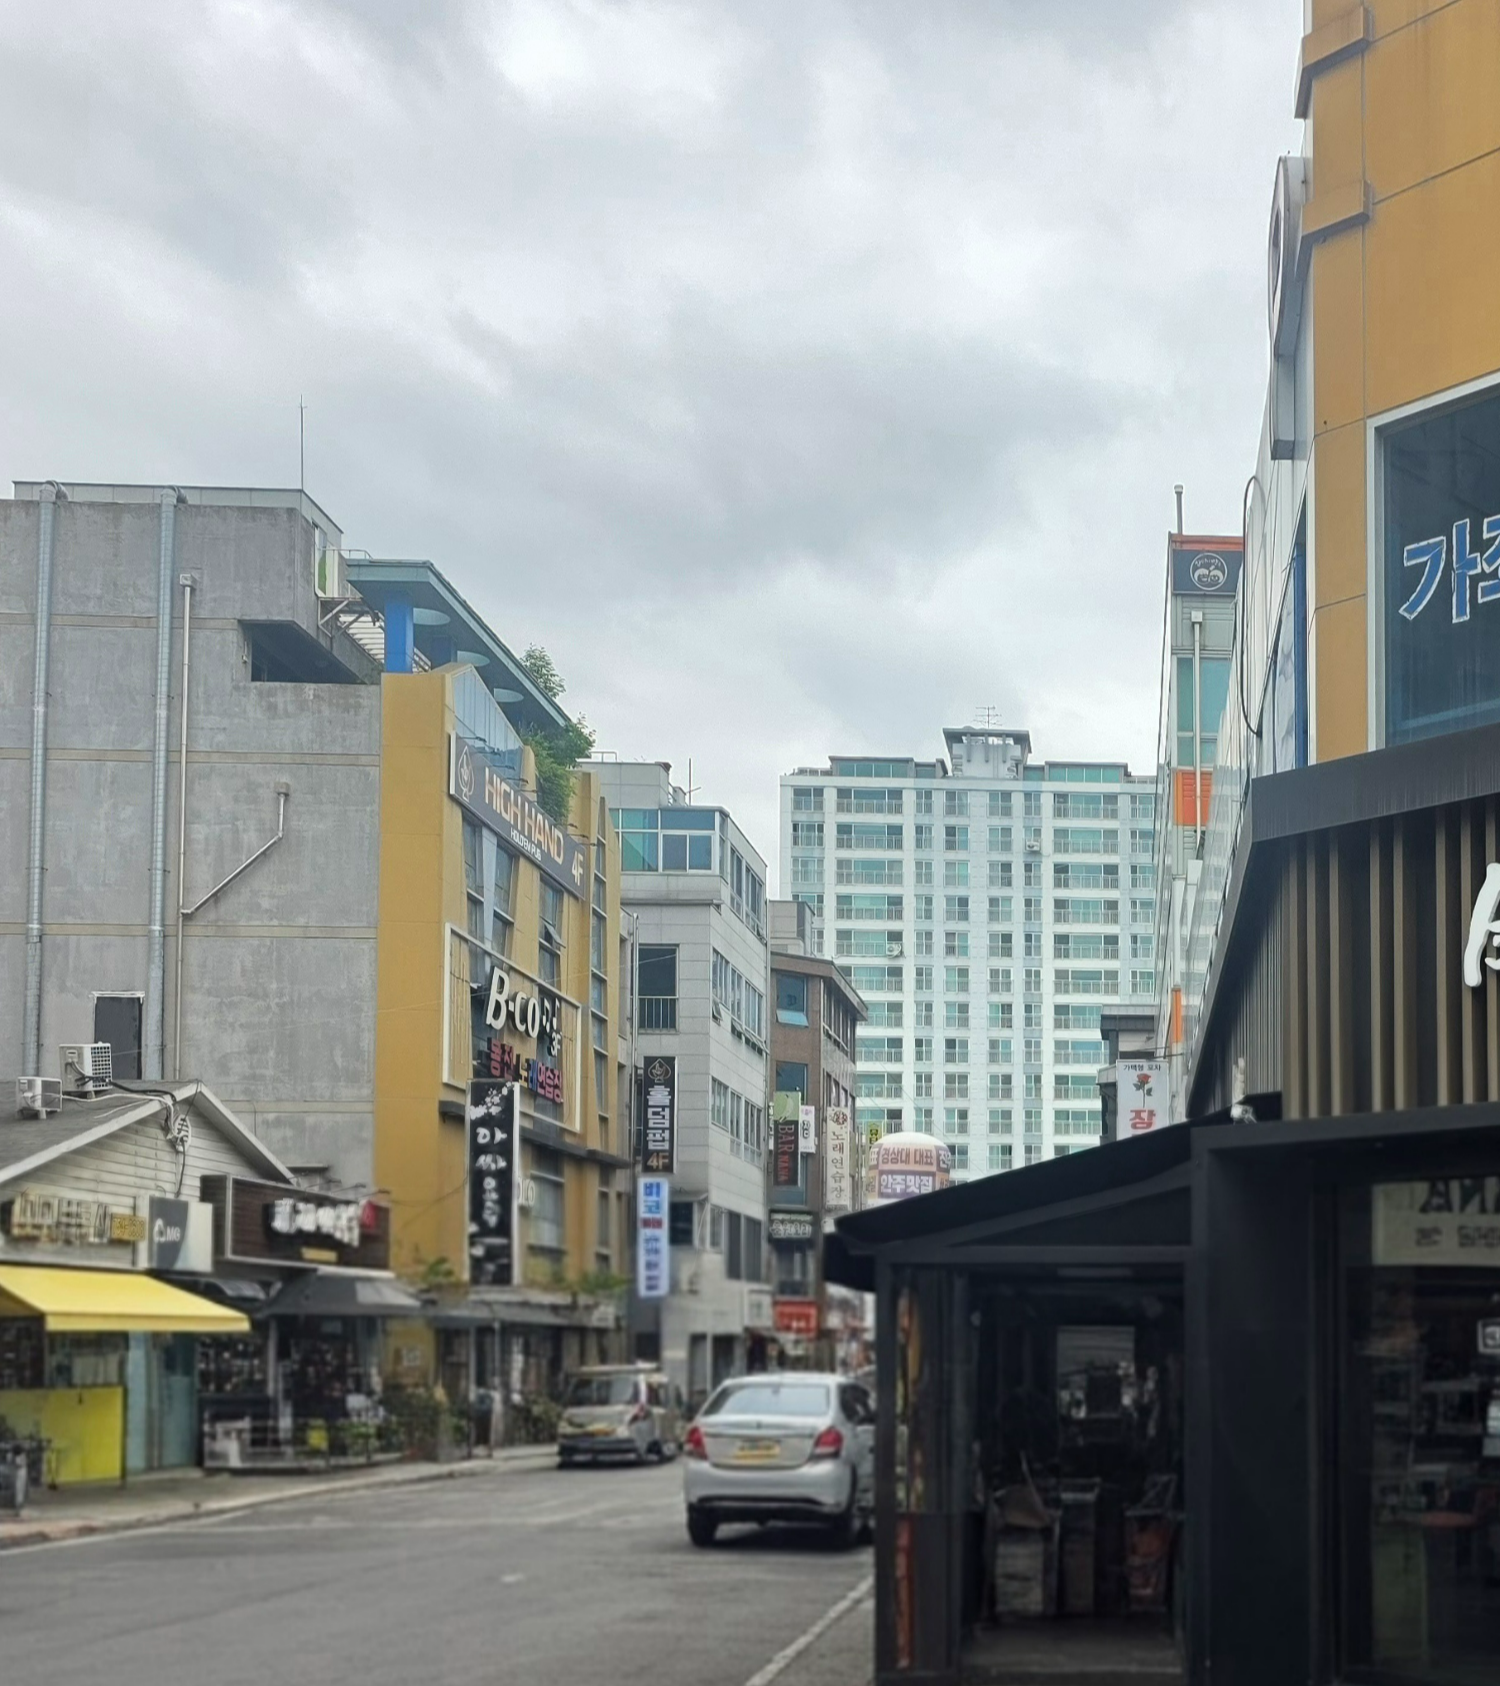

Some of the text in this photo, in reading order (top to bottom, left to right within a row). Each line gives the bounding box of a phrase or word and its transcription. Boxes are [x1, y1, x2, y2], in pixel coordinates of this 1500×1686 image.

[485, 766, 584, 887] HIGH HAND 4F
[647, 1085, 671, 1150] 홀덤펍
[1129, 1109, 1156, 1136] 장
[778, 1124, 795, 1153] BAR
[647, 1151, 669, 1170] 4F
[830, 1131, 846, 1199] 노래연습장
[881, 1146, 934, 1166] 경상대 대표
[880, 1173, 933, 1195] 안주맛집
[166, 1227, 181, 1242] MG
